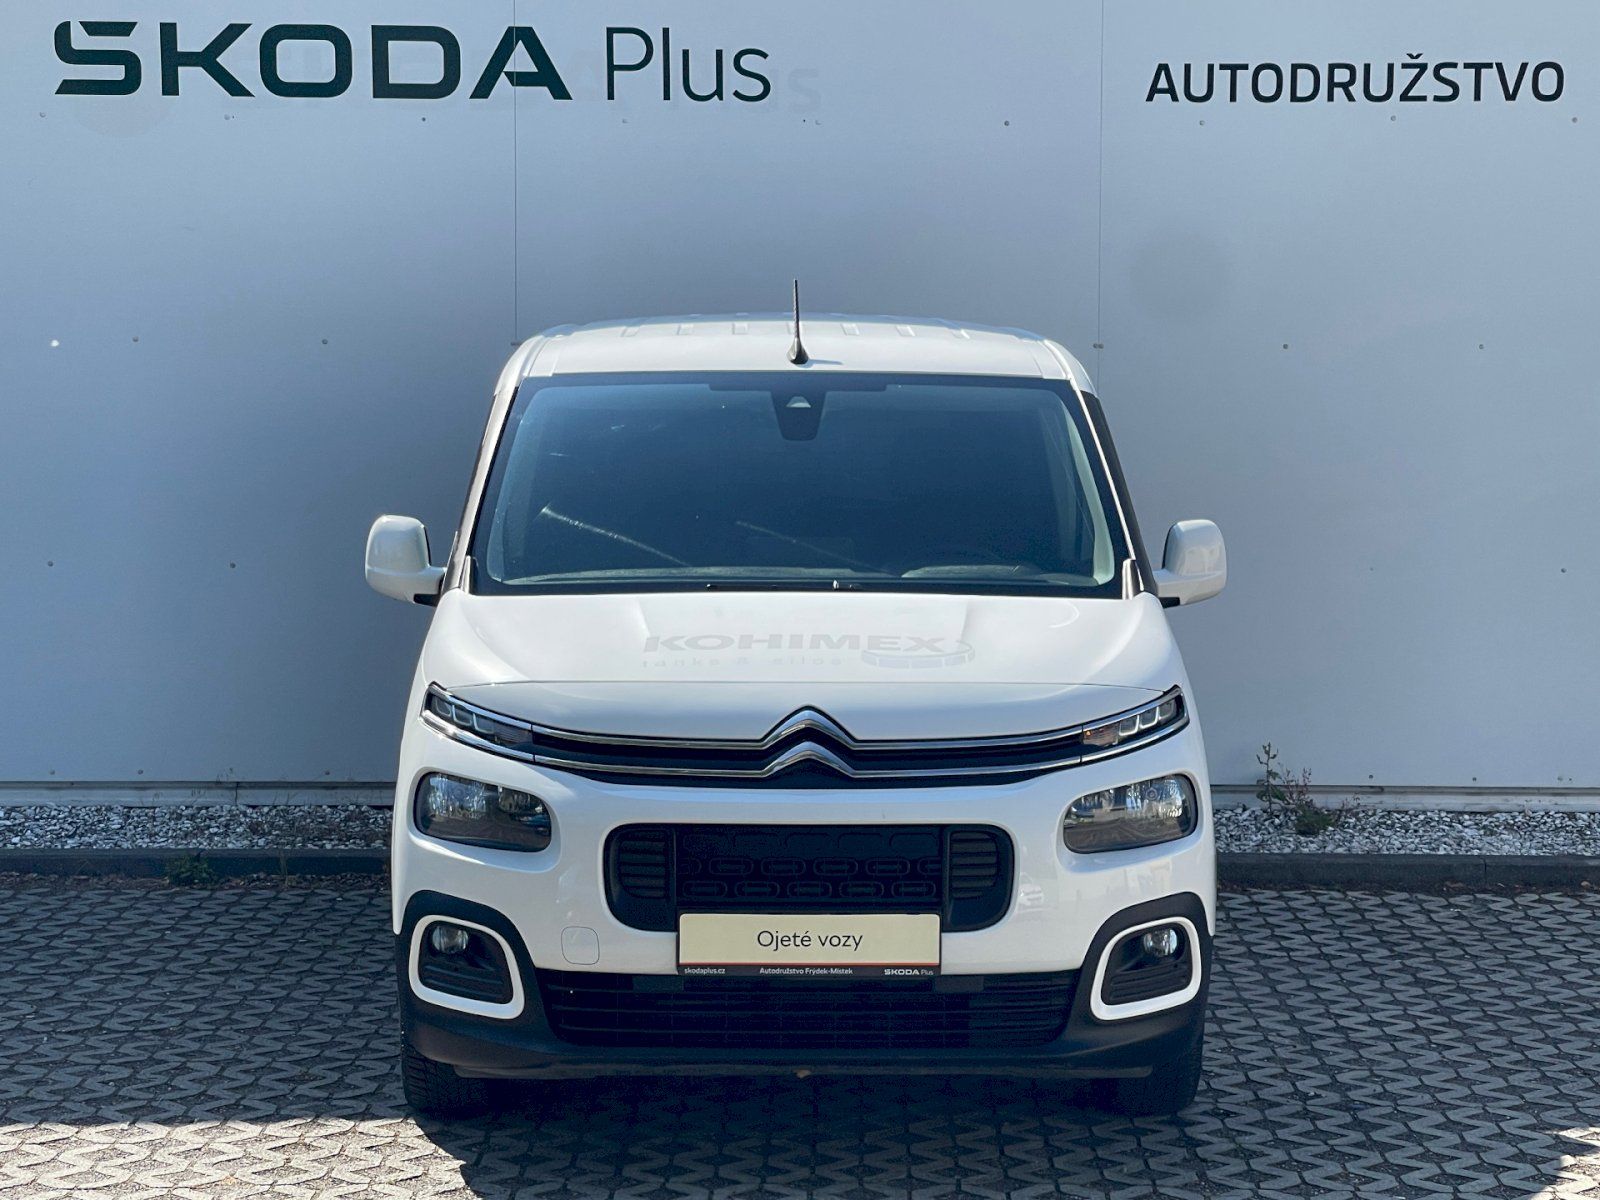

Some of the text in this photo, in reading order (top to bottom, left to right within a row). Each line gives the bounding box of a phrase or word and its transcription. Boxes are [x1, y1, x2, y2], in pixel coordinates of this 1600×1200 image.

[605, 26, 771, 102] Plus
[1145, 52, 1565, 103] AUTODRUŽSTVO
[643, 634, 946, 652] KOHIMEX
[757, 930, 863, 951] Ojeté vozy
[684, 967, 726, 975] skodaplus.cz
